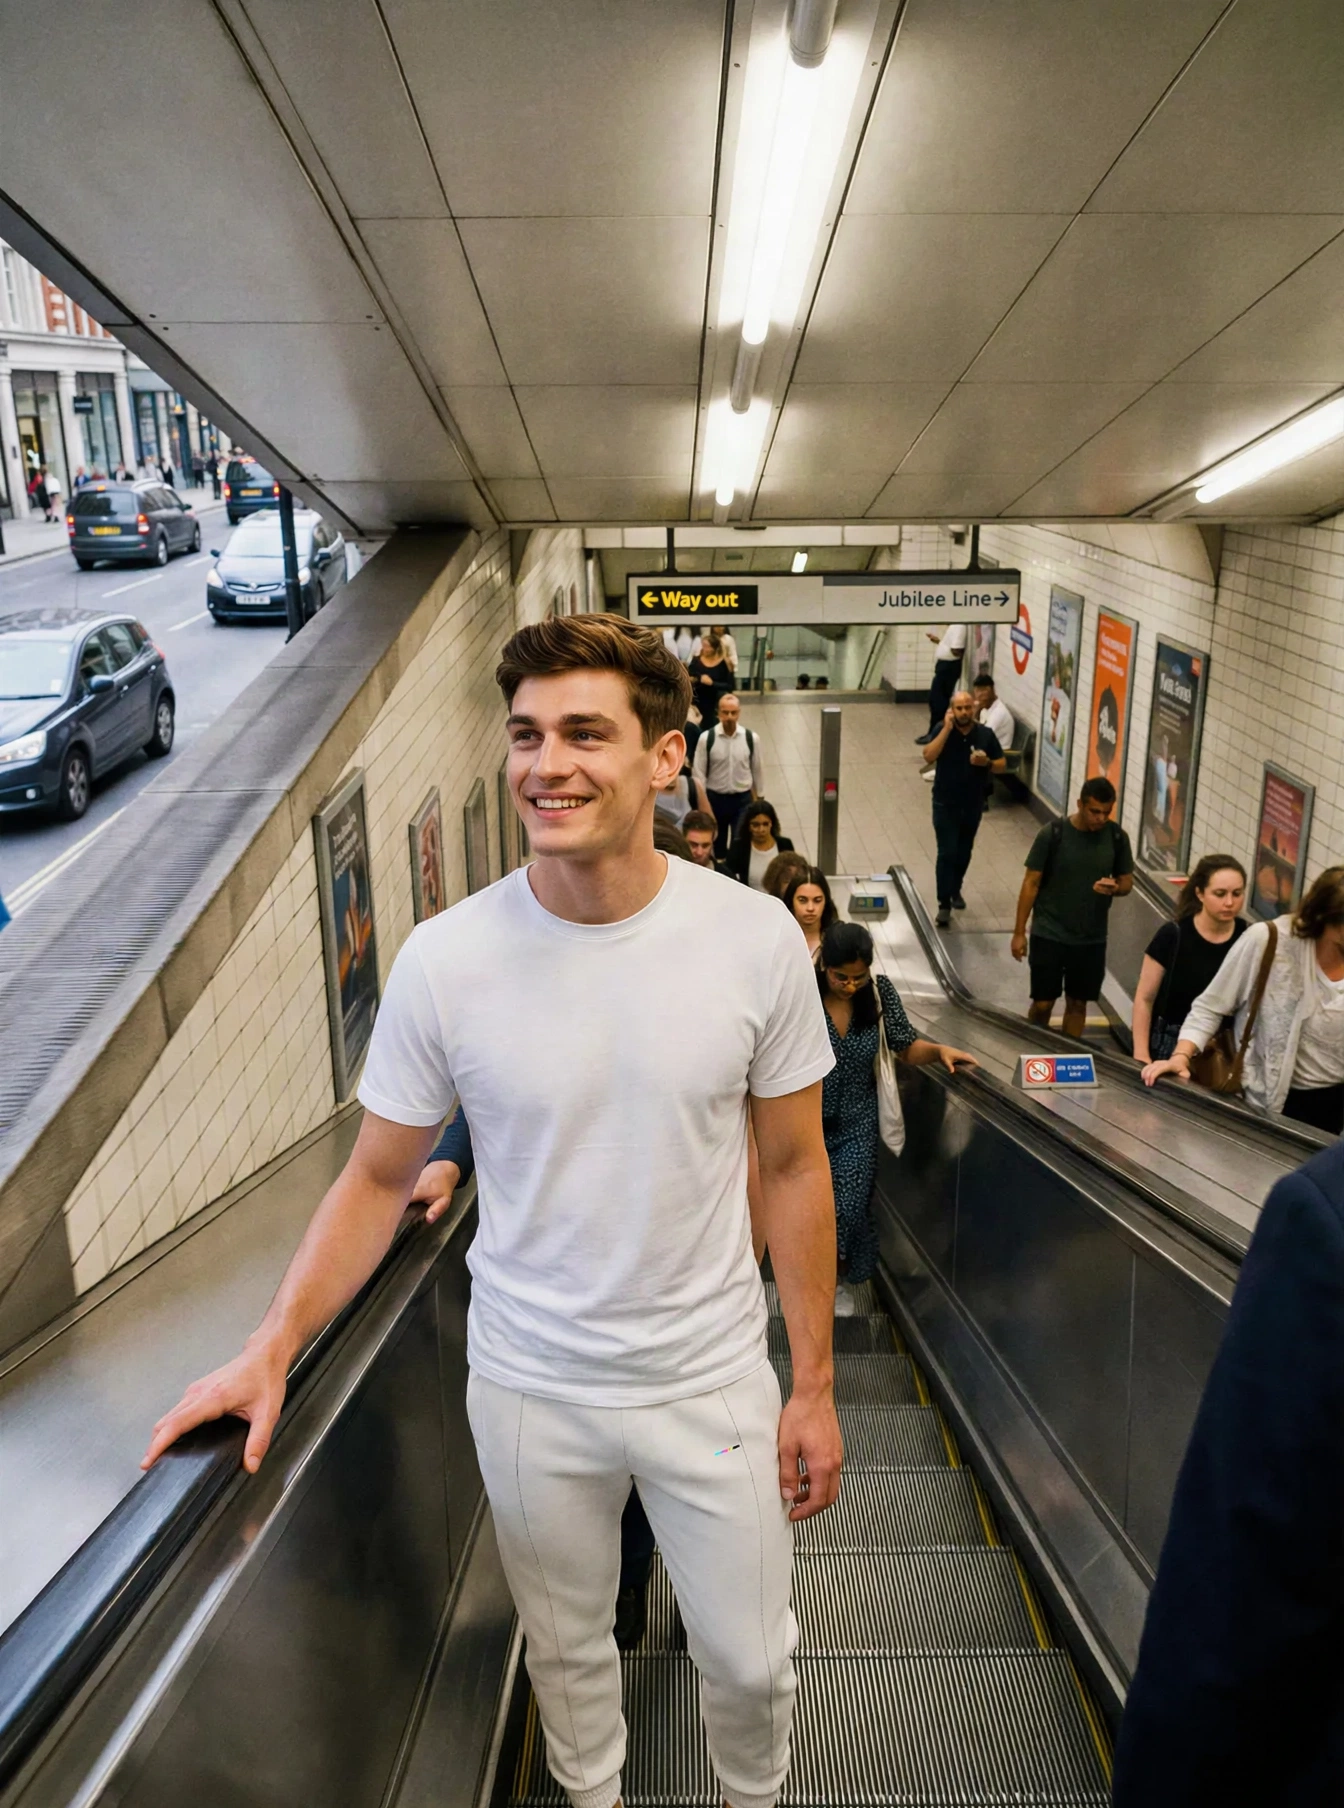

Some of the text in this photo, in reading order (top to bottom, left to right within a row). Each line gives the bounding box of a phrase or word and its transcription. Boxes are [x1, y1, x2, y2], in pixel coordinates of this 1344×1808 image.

[661, 590, 739, 612] Way out
[878, 590, 992, 608] Jubilee Line
